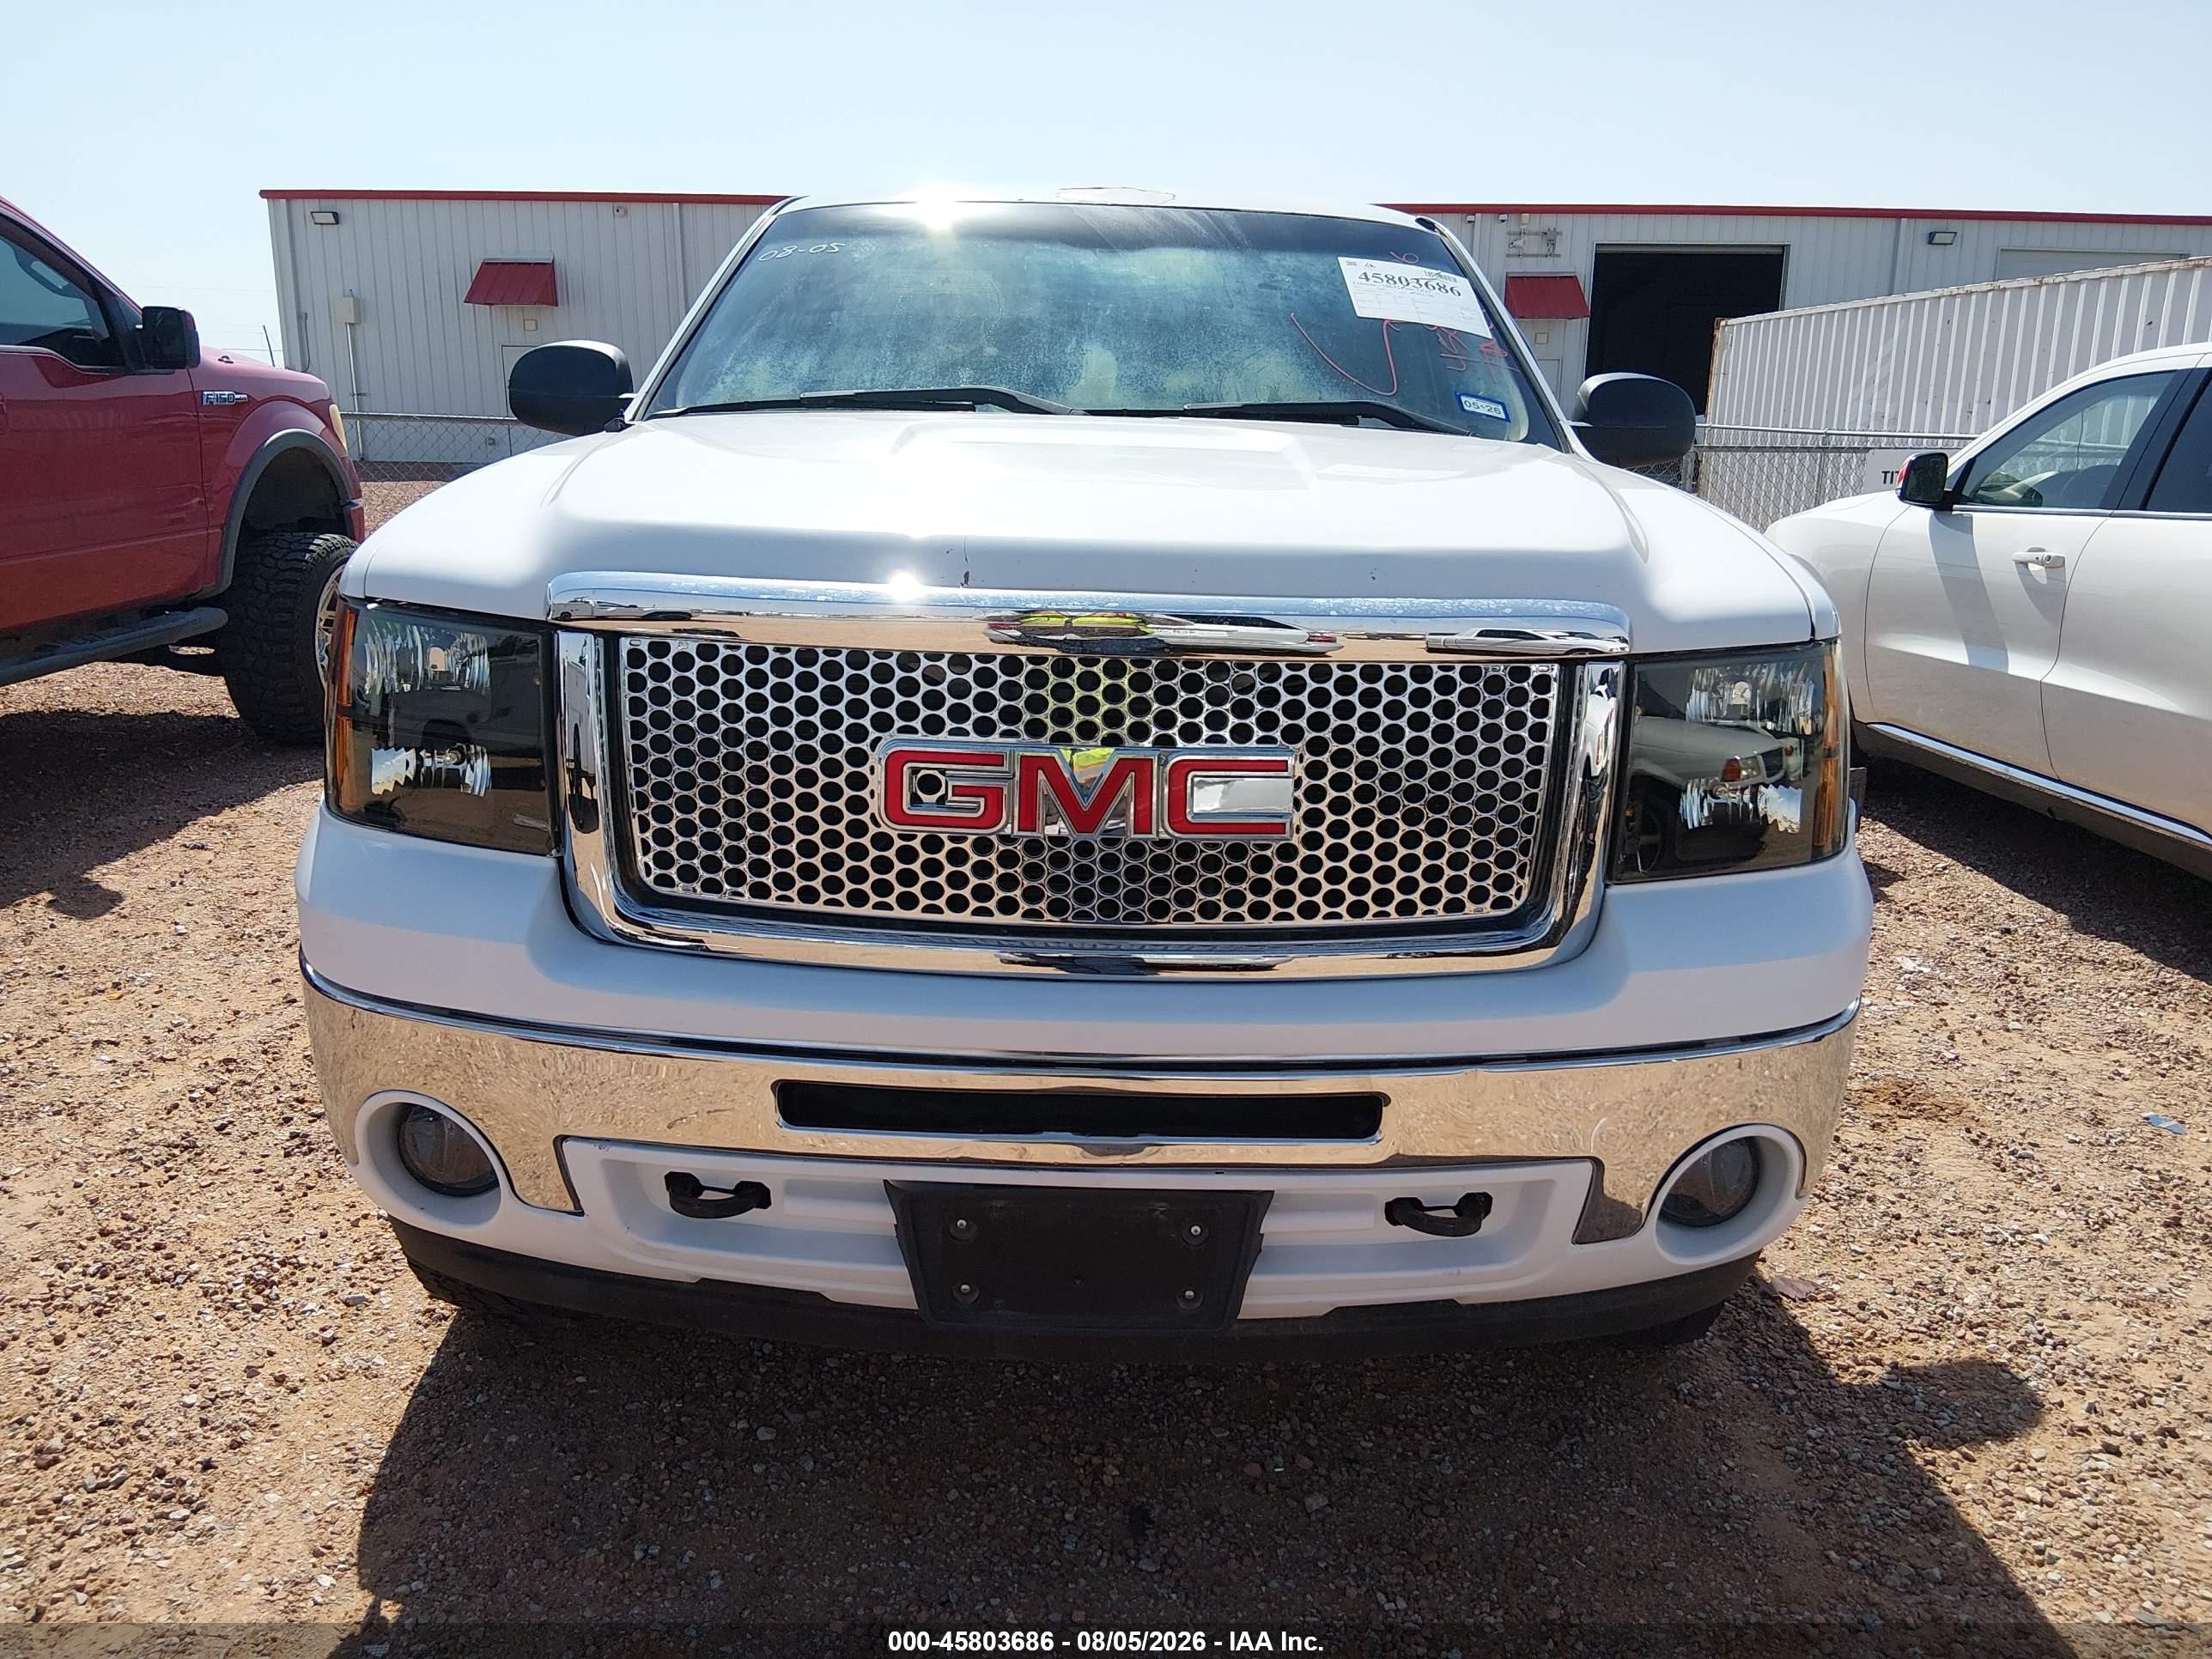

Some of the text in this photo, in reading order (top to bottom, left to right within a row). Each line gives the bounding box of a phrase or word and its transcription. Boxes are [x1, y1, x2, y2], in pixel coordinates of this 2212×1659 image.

[758, 242, 846, 261] 08-05
[1358, 270, 1462, 297] 45803686
[879, 741, 1294, 838] GMC
